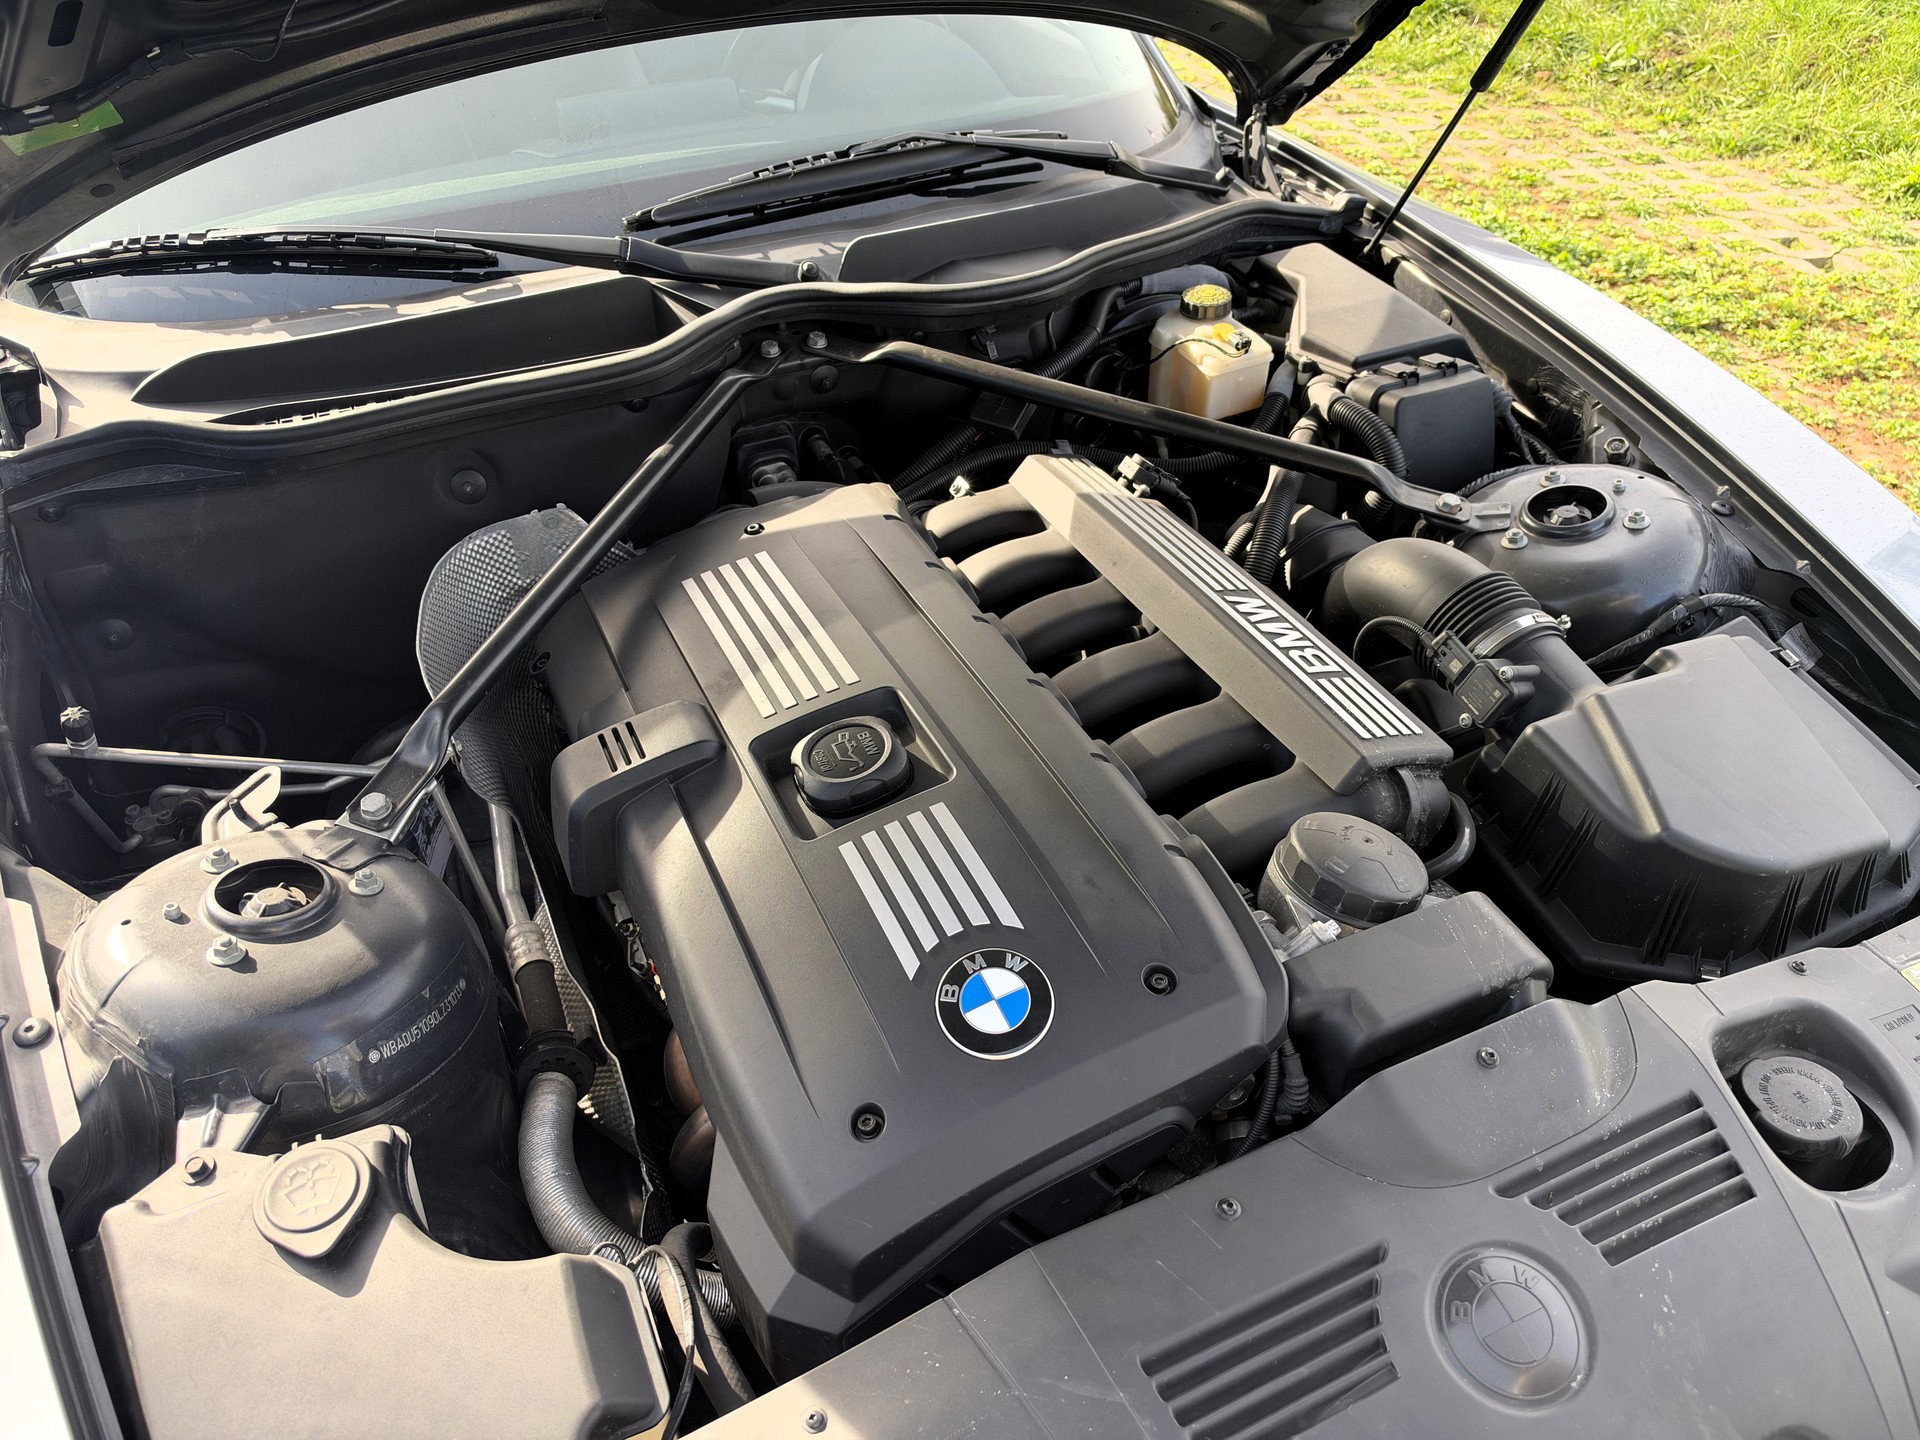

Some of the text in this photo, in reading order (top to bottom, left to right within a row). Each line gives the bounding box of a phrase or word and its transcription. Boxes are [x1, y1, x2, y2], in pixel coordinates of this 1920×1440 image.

[1223, 595, 1343, 674] BMW
[812, 749, 834, 773] Castrol
[856, 730, 882, 756] BMW
[940, 953, 1029, 1003] BMW
[380, 984, 463, 1059] WBADU51090LZ31013
[1763, 1097, 1782, 1114] OPEN
[1781, 1112, 1808, 1129] WHEN
[1808, 1120, 1827, 1130] HOT
[1450, 1263, 1542, 1324] BMW
